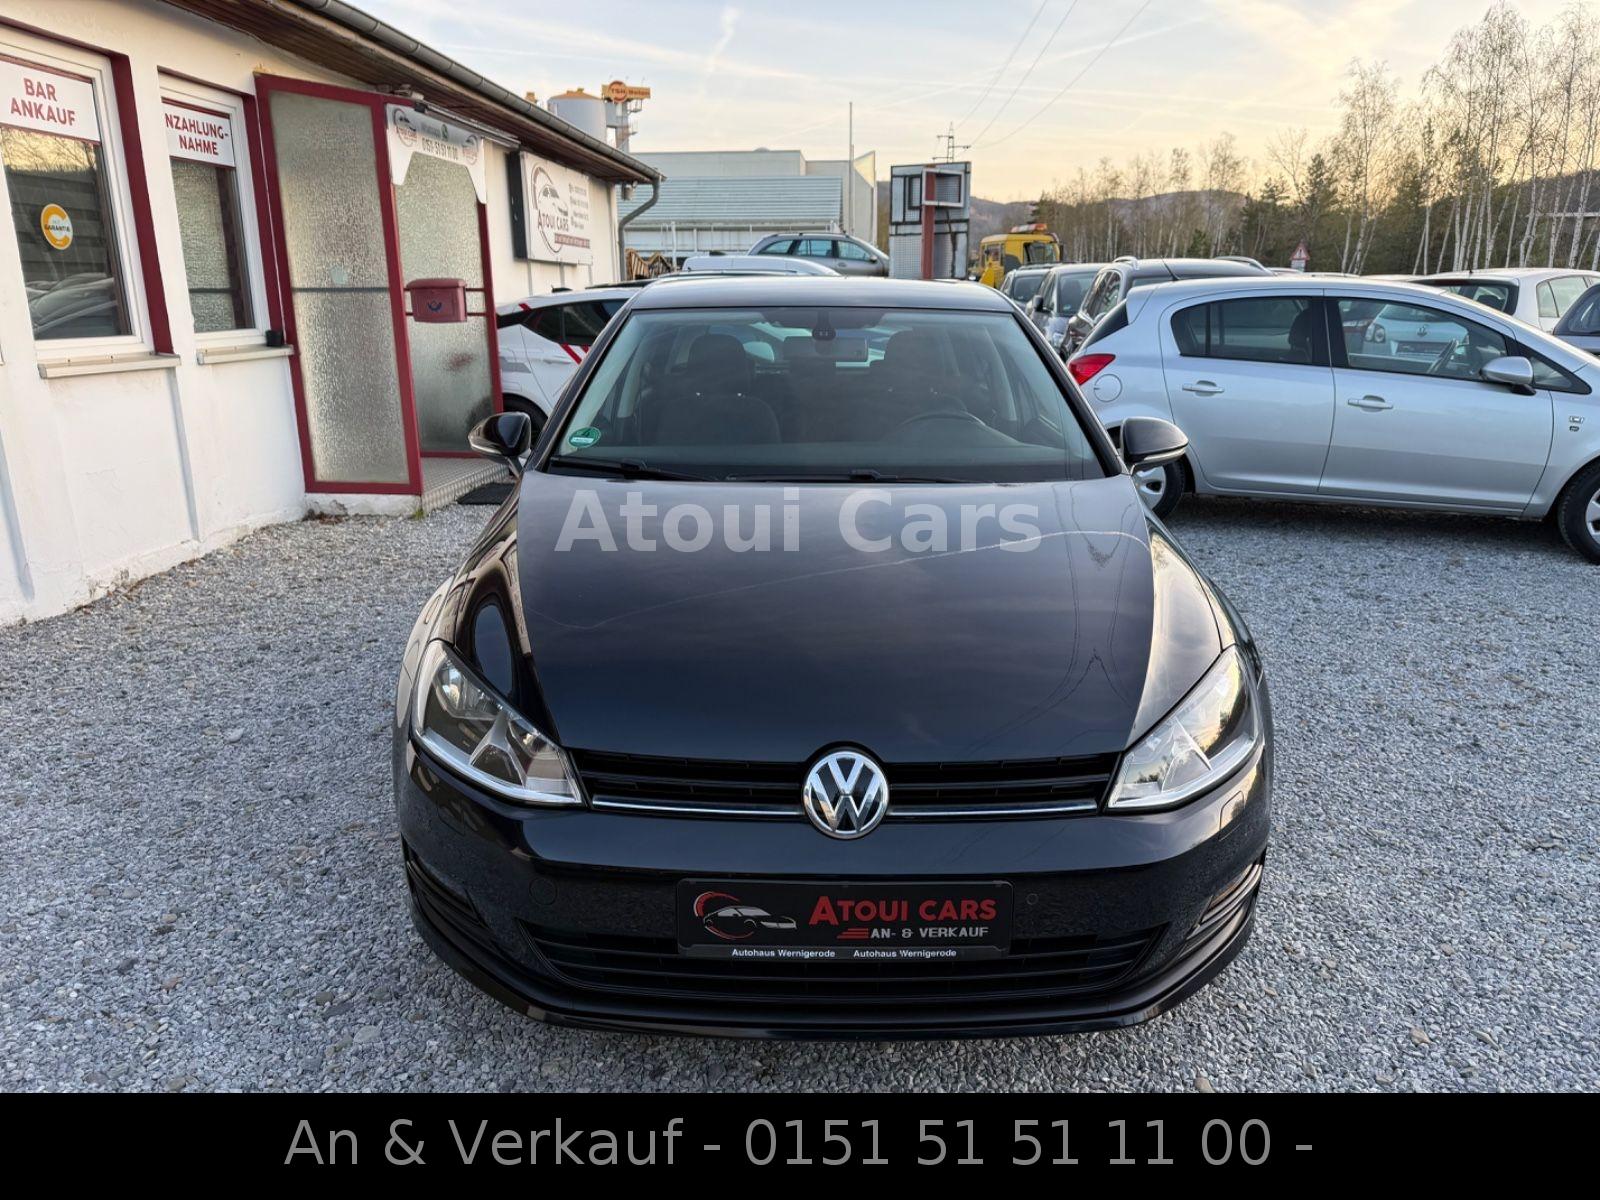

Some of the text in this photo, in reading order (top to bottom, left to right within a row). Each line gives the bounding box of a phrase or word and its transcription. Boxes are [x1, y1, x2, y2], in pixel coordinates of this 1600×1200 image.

[23, 77, 57, 102] BAR
[10, 98, 76, 127] ANKAUF
[164, 112, 229, 140] NZAHLUNG-
[178, 134, 219, 156] NAHME
[804, 752, 888, 838] VW
[809, 896, 997, 925] ATOUI CARS
[870, 926, 989, 939] AN- & VERKAUF
[732, 948, 836, 960] Autohaus Wernigerode
[853, 949, 957, 960] Autohaus Wernigerode
